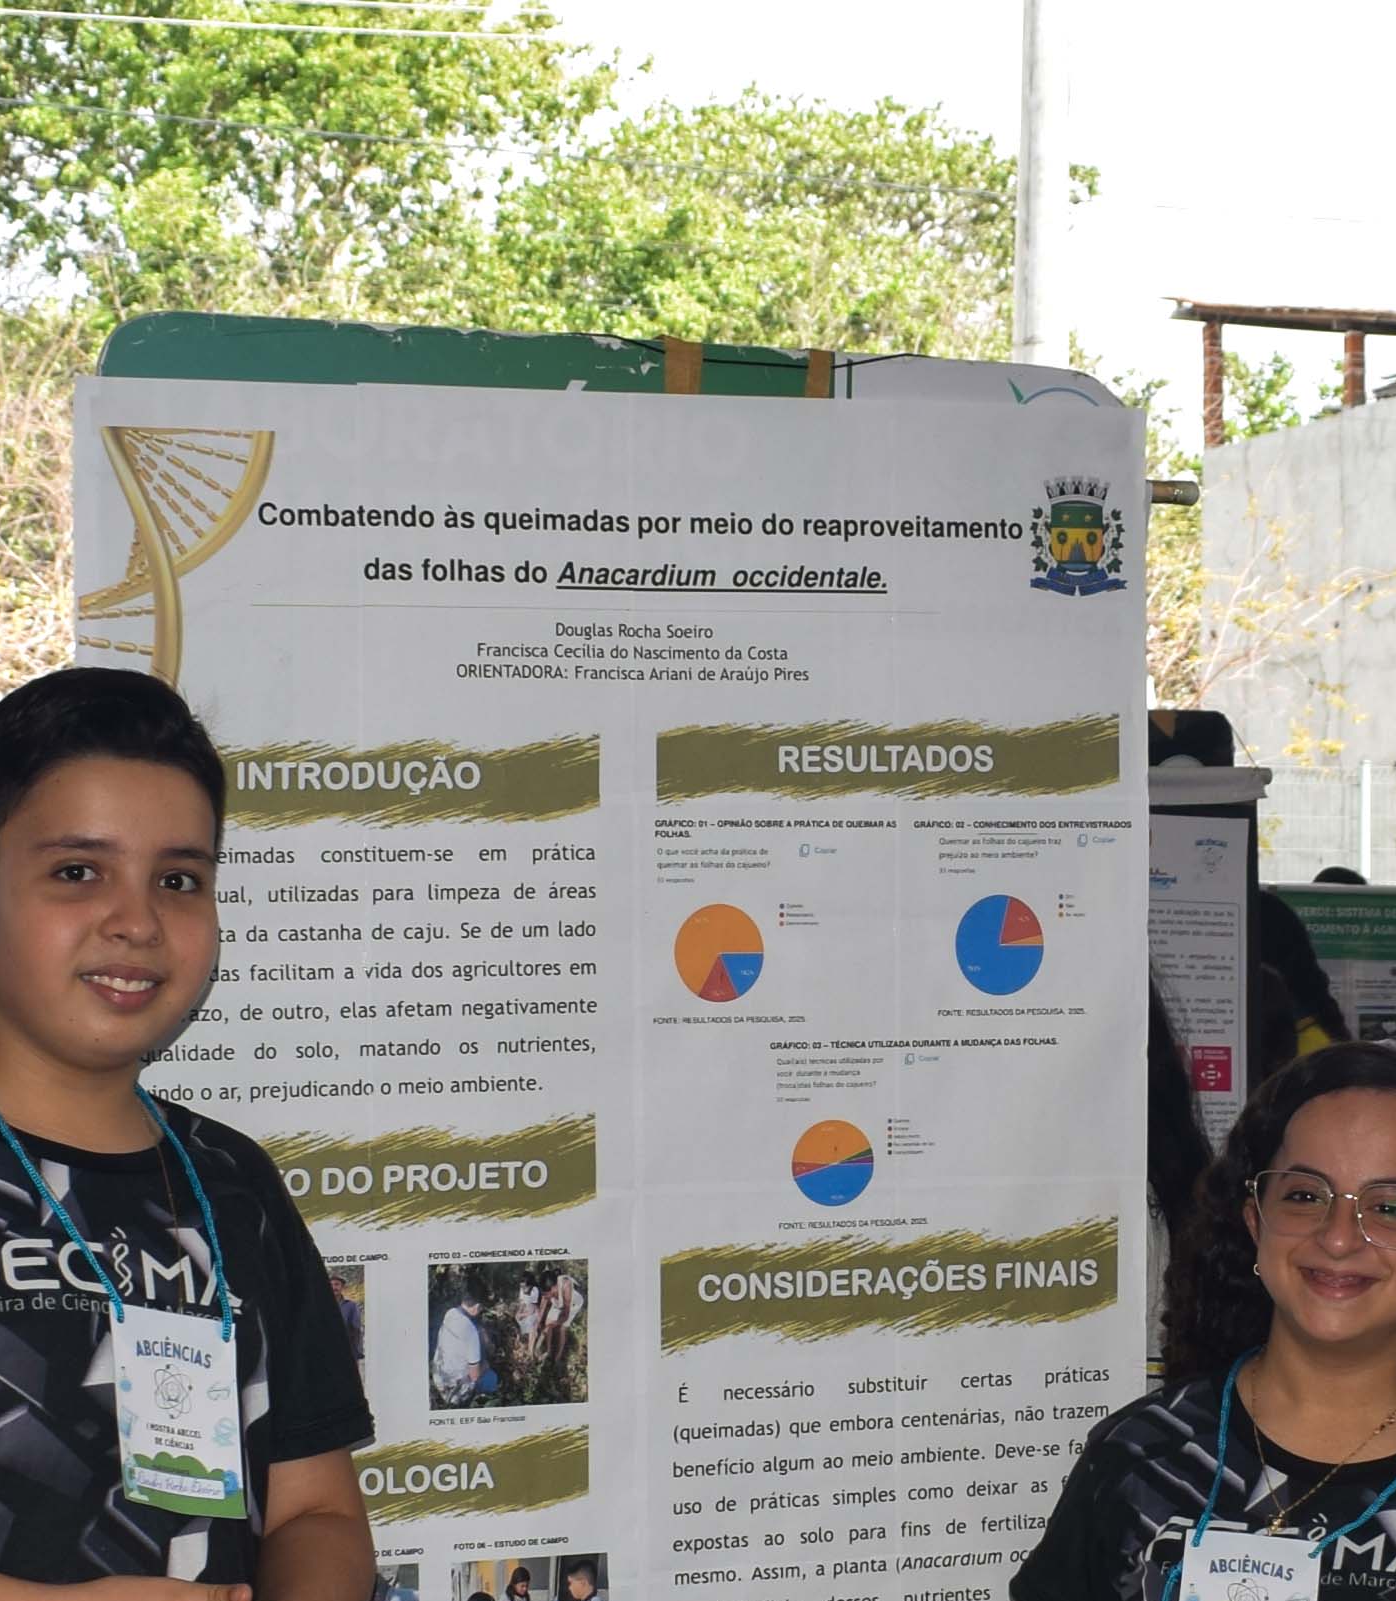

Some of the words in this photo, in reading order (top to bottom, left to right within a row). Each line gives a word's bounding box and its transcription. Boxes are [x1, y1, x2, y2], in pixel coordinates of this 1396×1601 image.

[257, 502, 435, 528] Combatendo
[443, 504, 475, 529] às
[483, 507, 629, 535] queimadas
[637, 516, 681, 539] por
[690, 511, 753, 535] meio
[761, 512, 794, 535] do
[803, 515, 1023, 542] reaproveitamento
[363, 557, 413, 581] das
[421, 558, 506, 583] folhas
[514, 560, 547, 584] do
[556, 561, 717, 589] Anacardium
[733, 563, 889, 592] occidentale.
[555, 622, 613, 640] Douglas
[618, 623, 661, 638] Rocha
[666, 624, 713, 639] Soeiro
[477, 642, 548, 658] Francisca
[553, 643, 605, 659] Cecília
[609, 644, 628, 659] do
[633, 645, 720, 660] Nascimento
[724, 645, 742, 660] da
[747, 645, 788, 660] Costa
[456, 663, 568, 679] ORIENTADORA:
[574, 665, 645, 680] Francisca
[649, 666, 692, 681] Ariani
[697, 666, 716, 681] de
[719, 666, 769, 684] Araújo
[773, 667, 809, 681] Pires
[778, 744, 993, 773] RESULTADOS
[237, 757, 481, 795] INTRODUÇÃO
[320, 845, 453, 863] constituem-se
[478, 848, 507, 861] em
[532, 842, 595, 865] prática
[268, 884, 359, 903] utilizadas
[372, 887, 414, 905] para
[428, 883, 500, 904] limpeza
[513, 882, 536, 899] de
[548, 881, 596, 899] áreas
[245, 925, 268, 942] da
[277, 923, 362, 942] castanha
[371, 923, 395, 940] de
[403, 922, 449, 944] caju.
[460, 922, 481, 939] Se
[490, 921, 513, 938] de
[522, 924, 549, 938] um
[558, 920, 596, 937] lado
[249, 963, 334, 981] facilitam
[343, 967, 354, 980] a
[365, 961, 402, 979] vida
[411, 961, 443, 978] dos
[452, 959, 561, 981] agricultores
[569, 962, 597, 976] em
[321, 1165, 373, 1195] DO
[383, 1159, 547, 1193] PROJETO
[698, 1260, 986, 1300] CONSIDERAÇÕES
[995, 1258, 1098, 1290] FINAIS
[31, 1292, 55, 1311] de
[136, 1337, 212, 1369] ABCIÊNCIAS
[678, 1382, 689, 1403] É
[723, 1380, 815, 1400] necessário
[848, 1374, 928, 1394] substituir
[960, 1372, 1012, 1388] certas
[1045, 1365, 1109, 1388] práticas
[673, 1419, 780, 1444] (queimadas)
[789, 1420, 821, 1438] que
[829, 1414, 893, 1432] embora
[901, 1407, 1005, 1428] centenárias,
[1014, 1405, 1045, 1421] não
[1052, 1404, 1109, 1420] trazem
[673, 1457, 754, 1478] benefício
[762, 1455, 814, 1476] algum
[822, 1456, 843, 1469] ao
[851, 1450, 893, 1467] meio
[900, 1446, 985, 1464] ambiente.
[995, 1443, 1060, 1459] Deve-se
[1209, 1554, 1294, 1582] ABCIÊNCIAS
